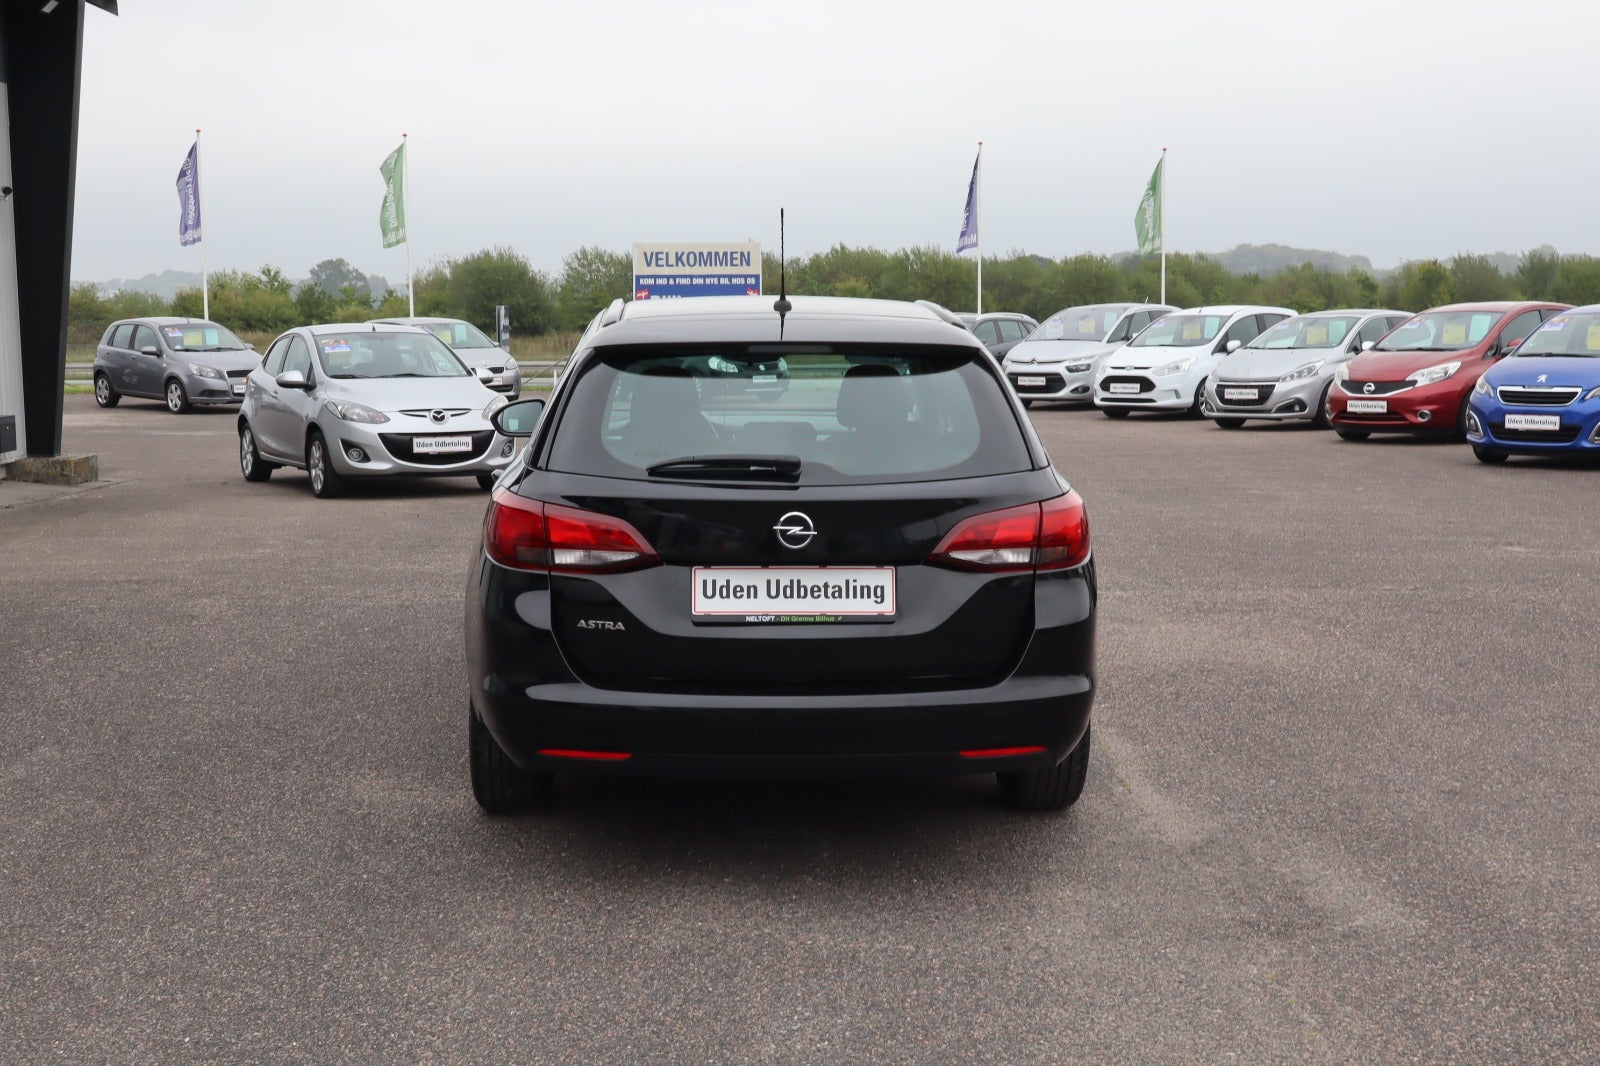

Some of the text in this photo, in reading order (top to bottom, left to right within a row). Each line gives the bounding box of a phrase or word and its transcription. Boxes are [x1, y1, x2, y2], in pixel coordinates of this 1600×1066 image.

[643, 251, 751, 267] VELKOMMEN
[720, 277, 730, 285] BIL
[747, 277, 755, 285] OS
[434, 440, 470, 448] Udbetaling
[702, 578, 885, 604] Uden Udbetaling
[576, 619, 625, 631] ASTRA
